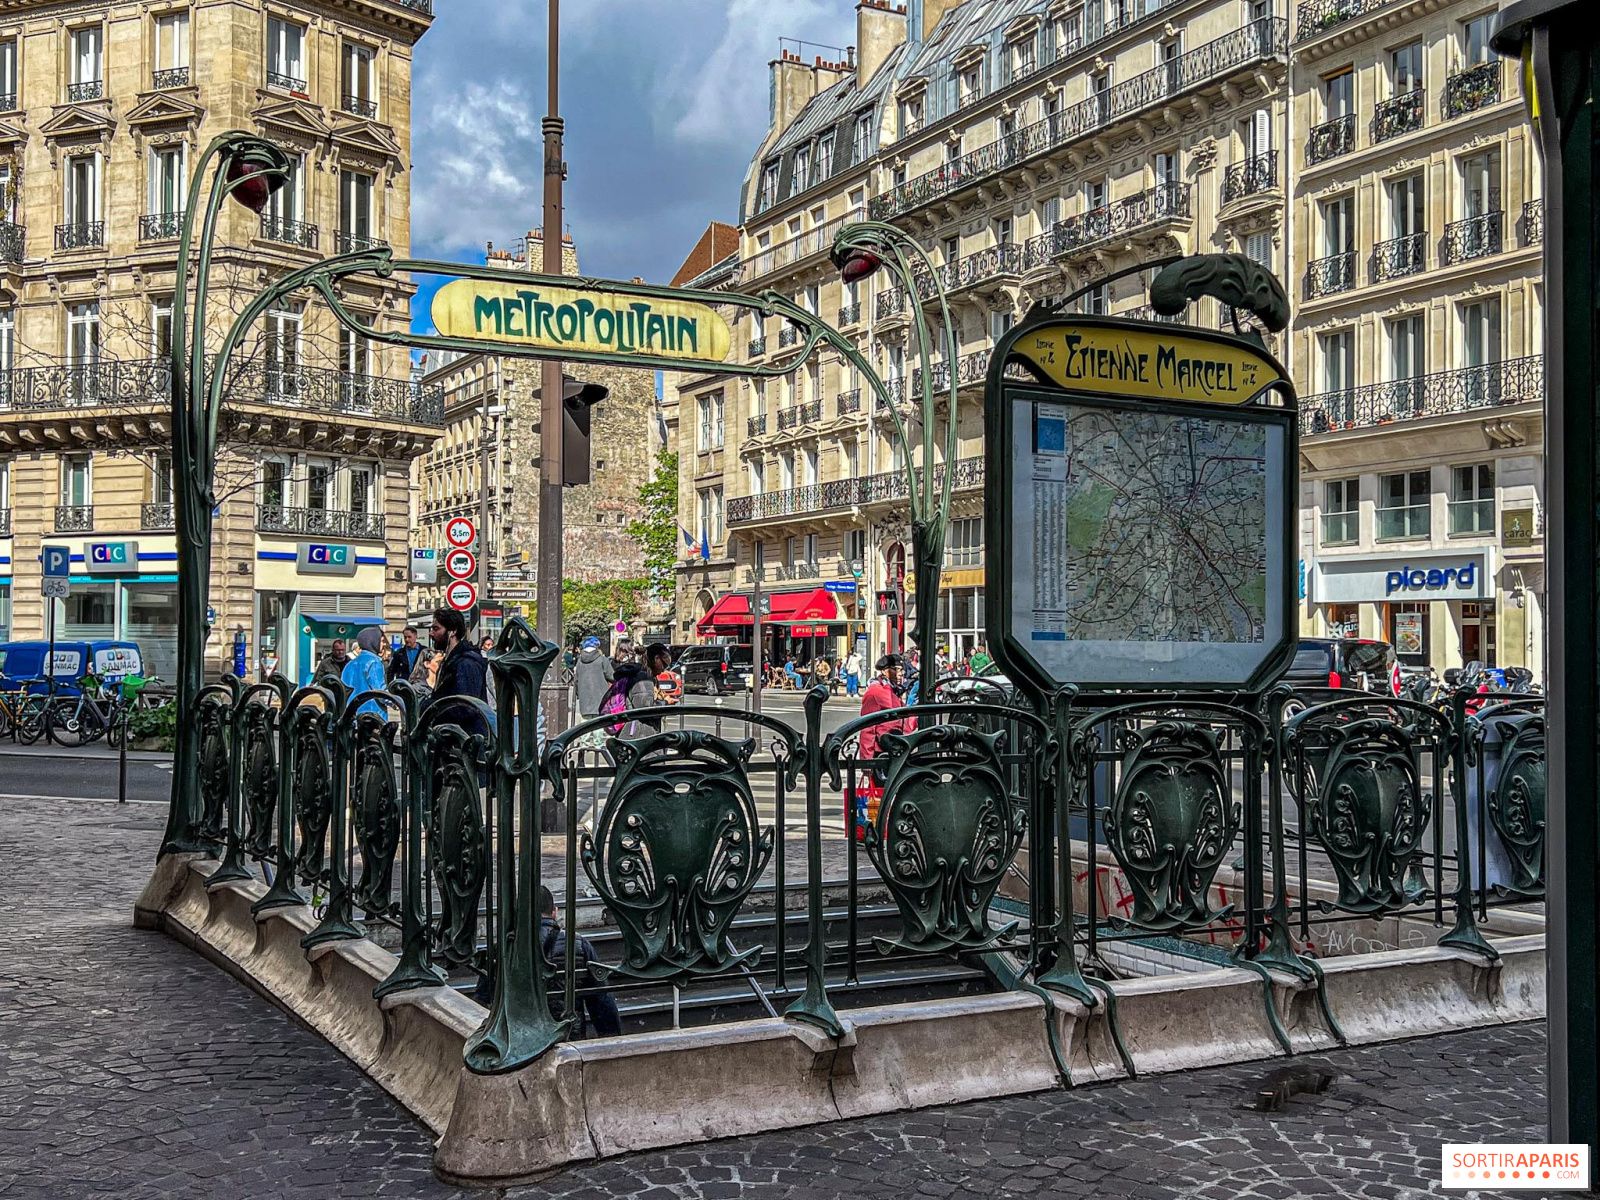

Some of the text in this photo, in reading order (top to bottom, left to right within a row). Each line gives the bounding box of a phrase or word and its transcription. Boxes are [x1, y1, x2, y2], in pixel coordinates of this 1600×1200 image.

[474, 289, 698, 353] METROPOLITAIN
[1156, 344, 1238, 396] MARCEL
[1503, 529, 1531, 539] carac
[94, 546, 123, 561] CIC
[312, 548, 344, 562] CIC
[415, 550, 433, 558] CIC
[50, 551, 63, 572] P
[1386, 562, 1475, 594] picard
[45, 662, 78, 671] SNMAC
[101, 660, 137, 671] SANMAC
